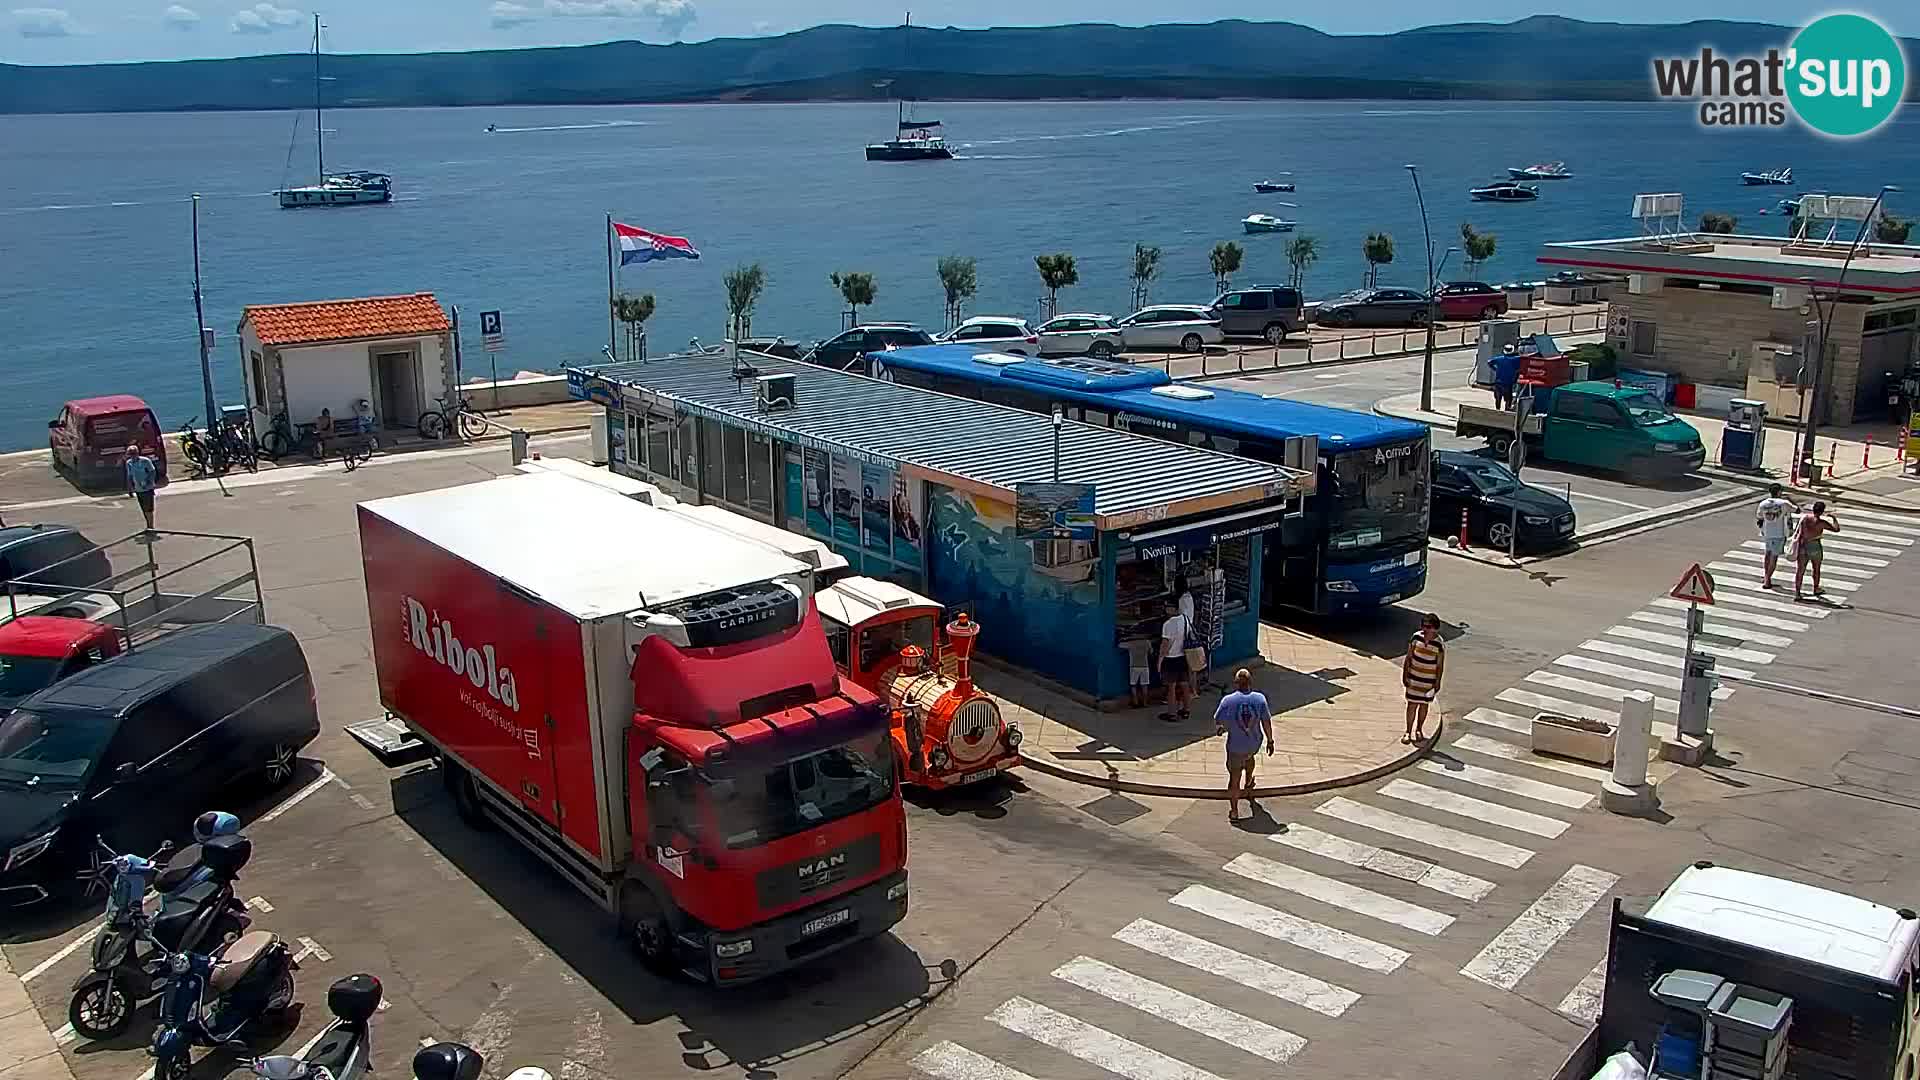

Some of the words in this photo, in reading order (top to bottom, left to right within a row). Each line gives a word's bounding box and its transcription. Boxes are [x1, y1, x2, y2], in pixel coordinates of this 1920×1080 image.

[485, 314, 496, 332] P
[798, 434, 812, 446] BUS
[813, 438, 843, 455] STATION
[845, 447, 870, 462] TICKET
[871, 454, 897, 469] OFFICE
[719, 609, 776, 629] CARRIER
[406, 597, 520, 712] Ribola
[799, 853, 845, 877] MAN
